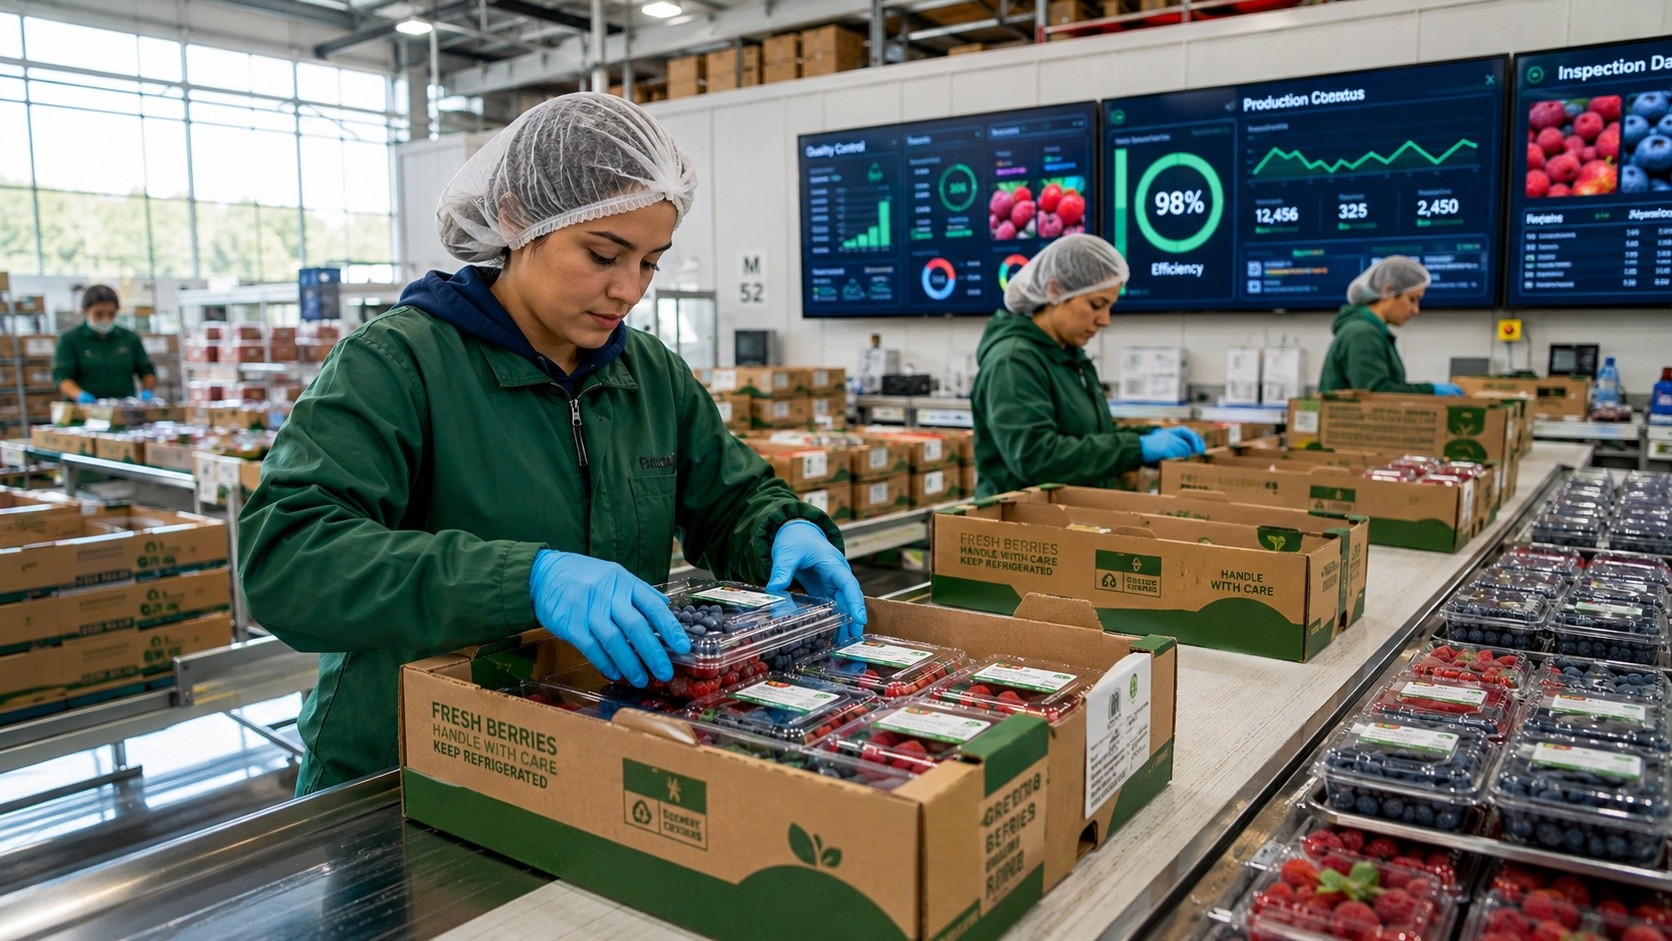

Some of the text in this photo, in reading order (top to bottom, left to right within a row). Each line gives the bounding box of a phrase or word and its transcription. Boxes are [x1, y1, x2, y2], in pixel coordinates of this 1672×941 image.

[1558, 54, 1672, 81] Inspection Da
[1243, 93, 1309, 112] Production
[806, 140, 866, 158] Quality Control
[1155, 189, 1206, 217] 98%
[1338, 203, 1369, 220] 325
[1417, 198, 1460, 218] 2,450
[1255, 206, 1299, 224] 12,456
[743, 256, 761, 275] M
[1151, 261, 1204, 278] Efficiency
[739, 284, 765, 303] 52
[960, 533, 1059, 555] FRESH BERRIES
[960, 546, 998, 559] HANDLE
[1030, 555, 1058, 566] CARE
[960, 556, 1053, 576] KEEP REFRIGERATED
[1221, 569, 1264, 583] HANDLE
[1210, 580, 1275, 597] WITH CARE
[431, 701, 558, 756] FRESH BERRIES
[433, 723, 558, 775] HANDLE WITH CARE
[433, 739, 548, 789] KEEP REFRIGERATED
